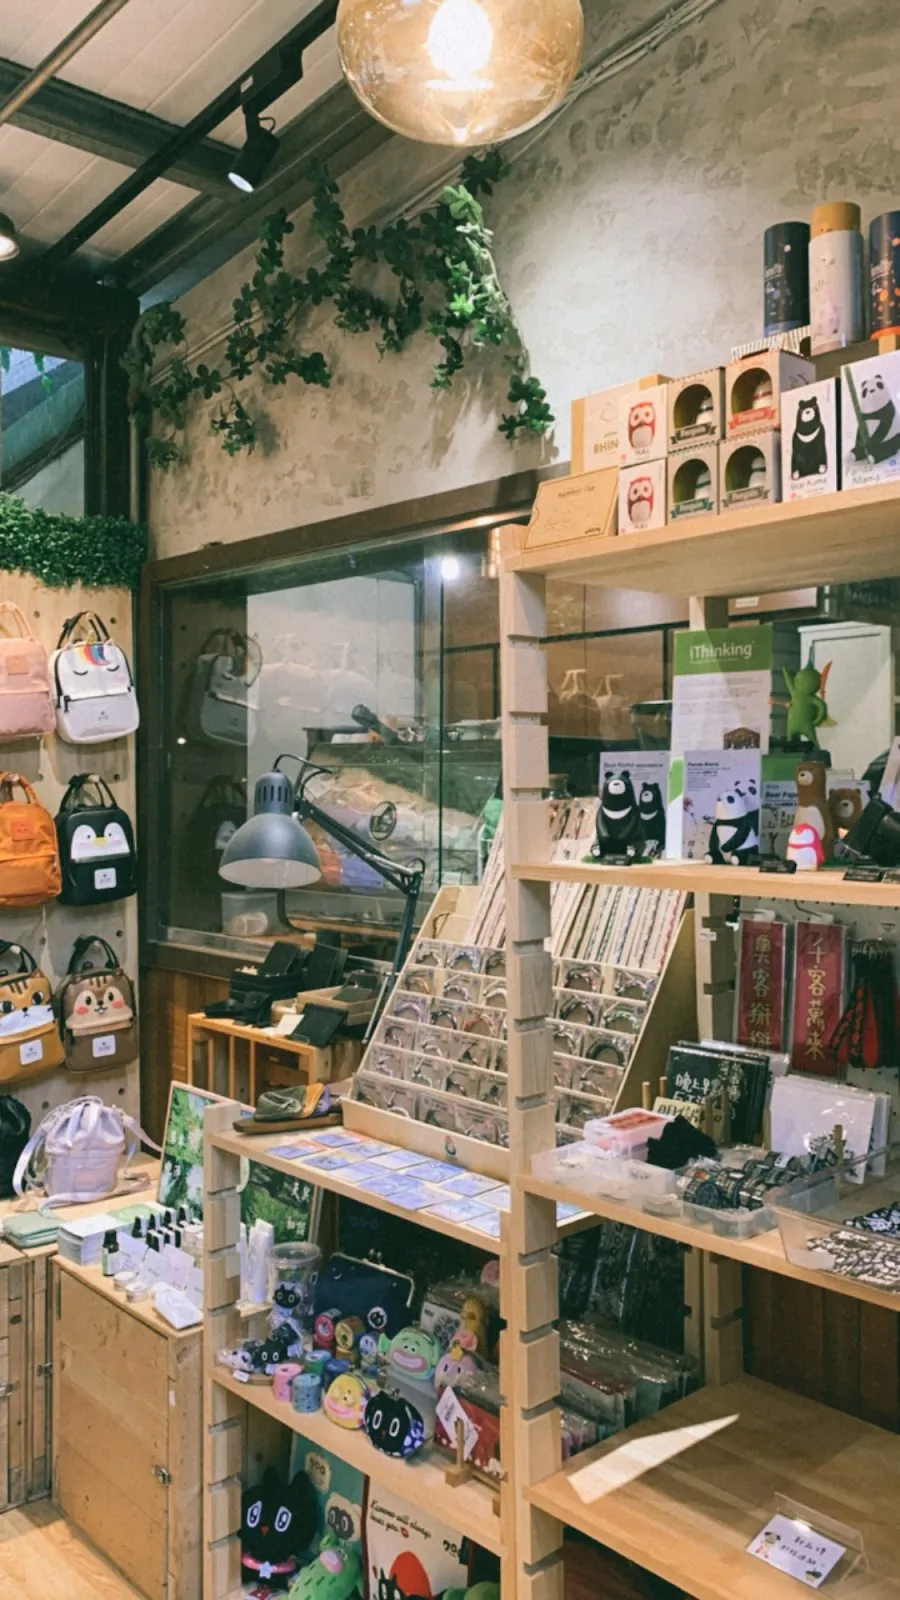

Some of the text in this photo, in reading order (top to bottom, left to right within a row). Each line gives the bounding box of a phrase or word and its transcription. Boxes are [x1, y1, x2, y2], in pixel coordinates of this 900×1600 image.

[593, 438, 619, 454] RHIN
[690, 642, 752, 660] iThinking
[804, 937, 828, 1061] 千客萬來
